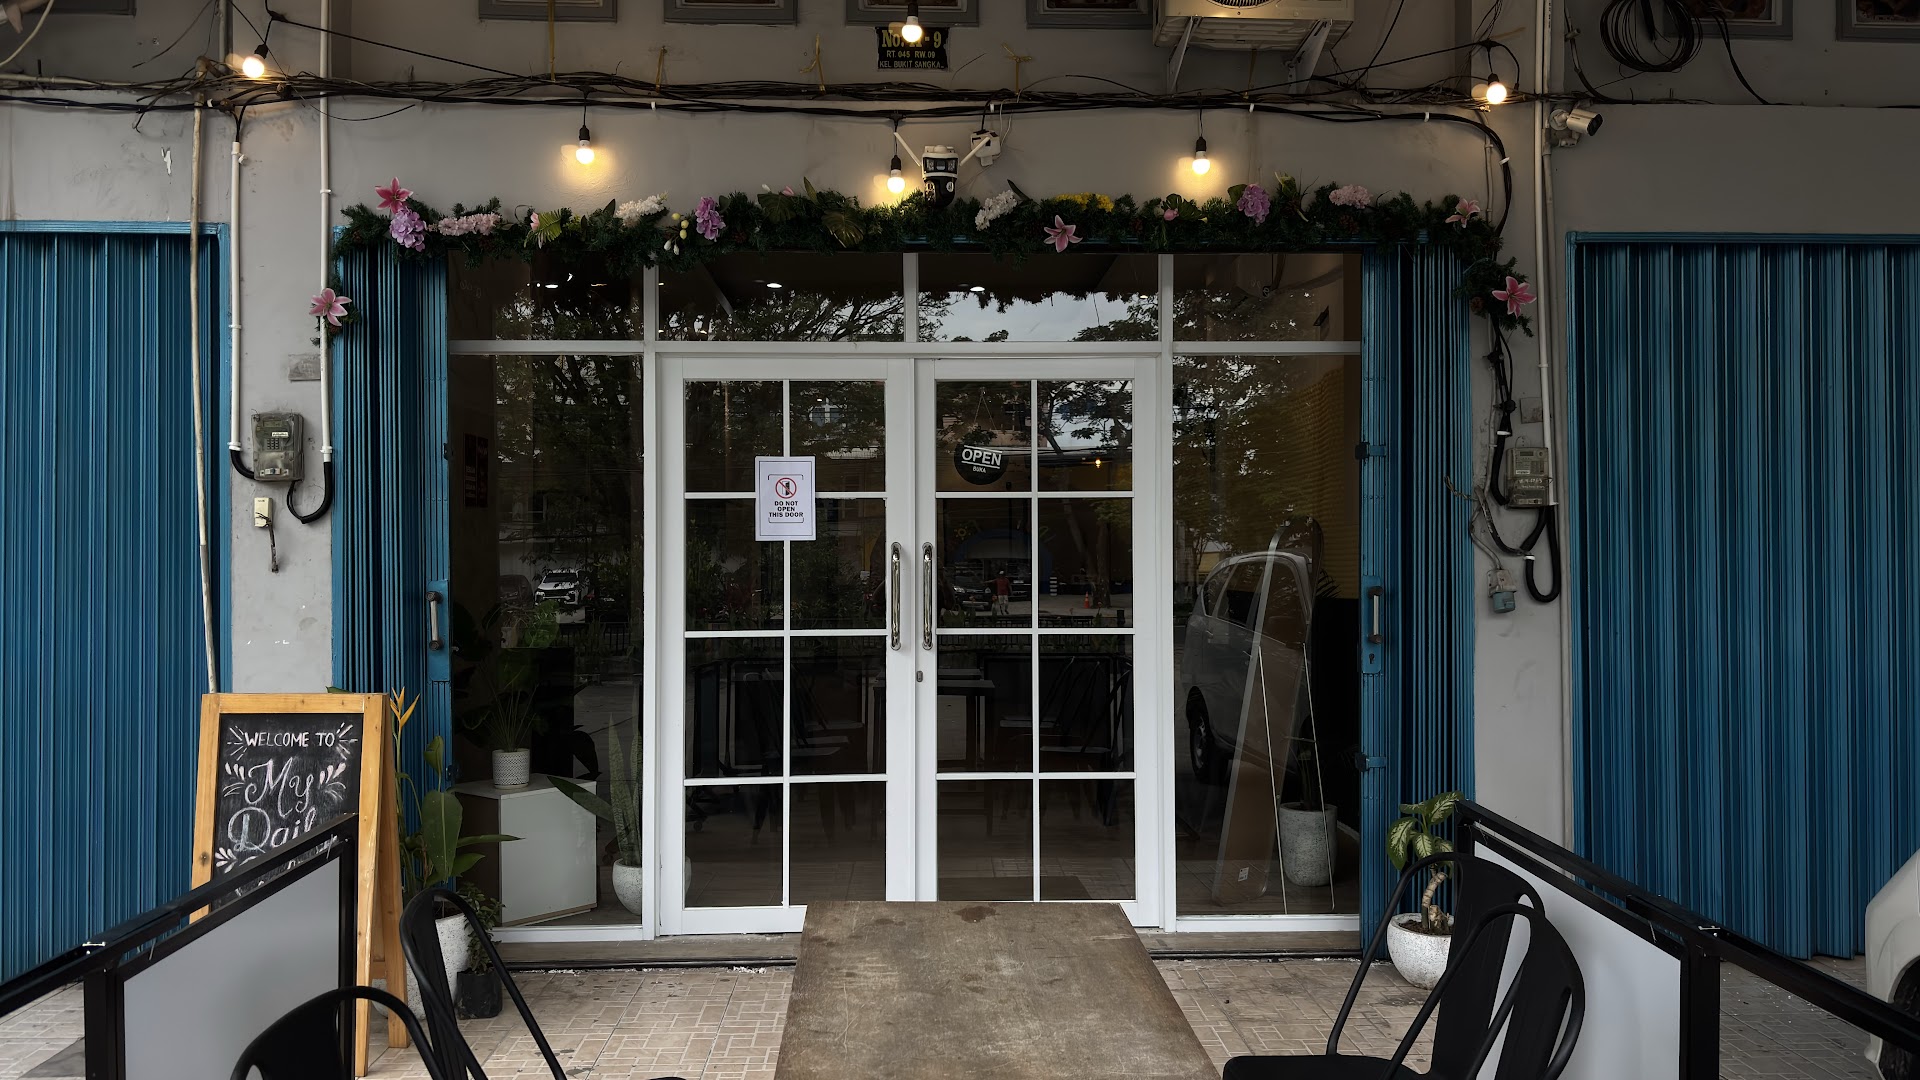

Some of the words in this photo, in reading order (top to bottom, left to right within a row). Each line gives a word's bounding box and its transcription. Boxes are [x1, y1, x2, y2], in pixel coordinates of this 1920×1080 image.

[962, 448, 1001, 466] OPEN
[244, 731, 309, 748] WELCOME
[315, 732, 336, 747] TO
[244, 756, 314, 818] My
